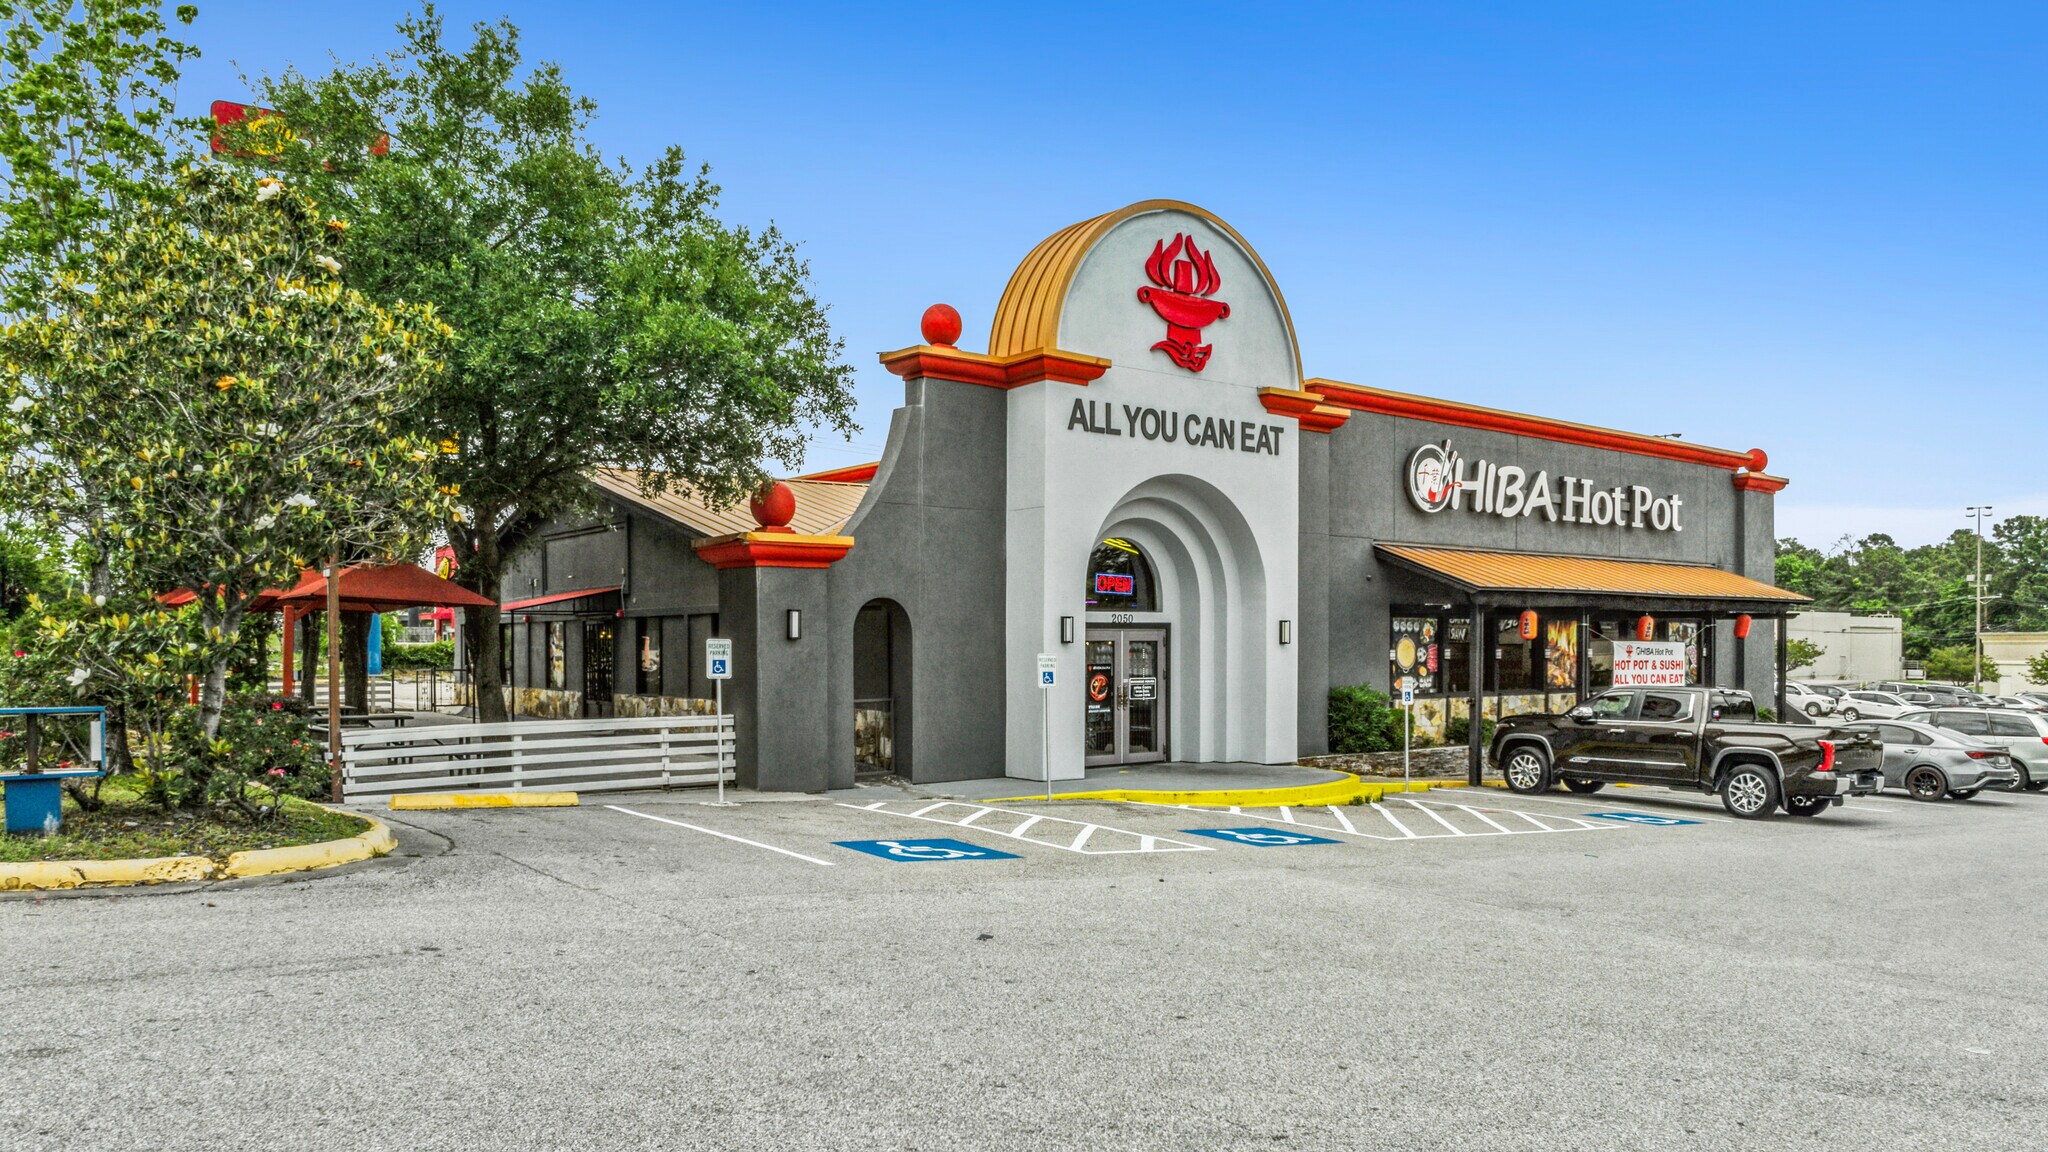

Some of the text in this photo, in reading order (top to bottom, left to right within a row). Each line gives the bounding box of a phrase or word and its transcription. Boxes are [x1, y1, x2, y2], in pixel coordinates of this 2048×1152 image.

[1068, 398, 1284, 456] ALL YOU CAN EAT
[1562, 476, 1626, 526] Hot
[1632, 485, 1682, 532] Pot
[1097, 575, 1131, 593] OPEN
[1111, 613, 1134, 623] 2050
[1614, 659, 1684, 670] HOT POT & SUSHI
[1614, 674, 1684, 684] ALL YOU CAN EAT
